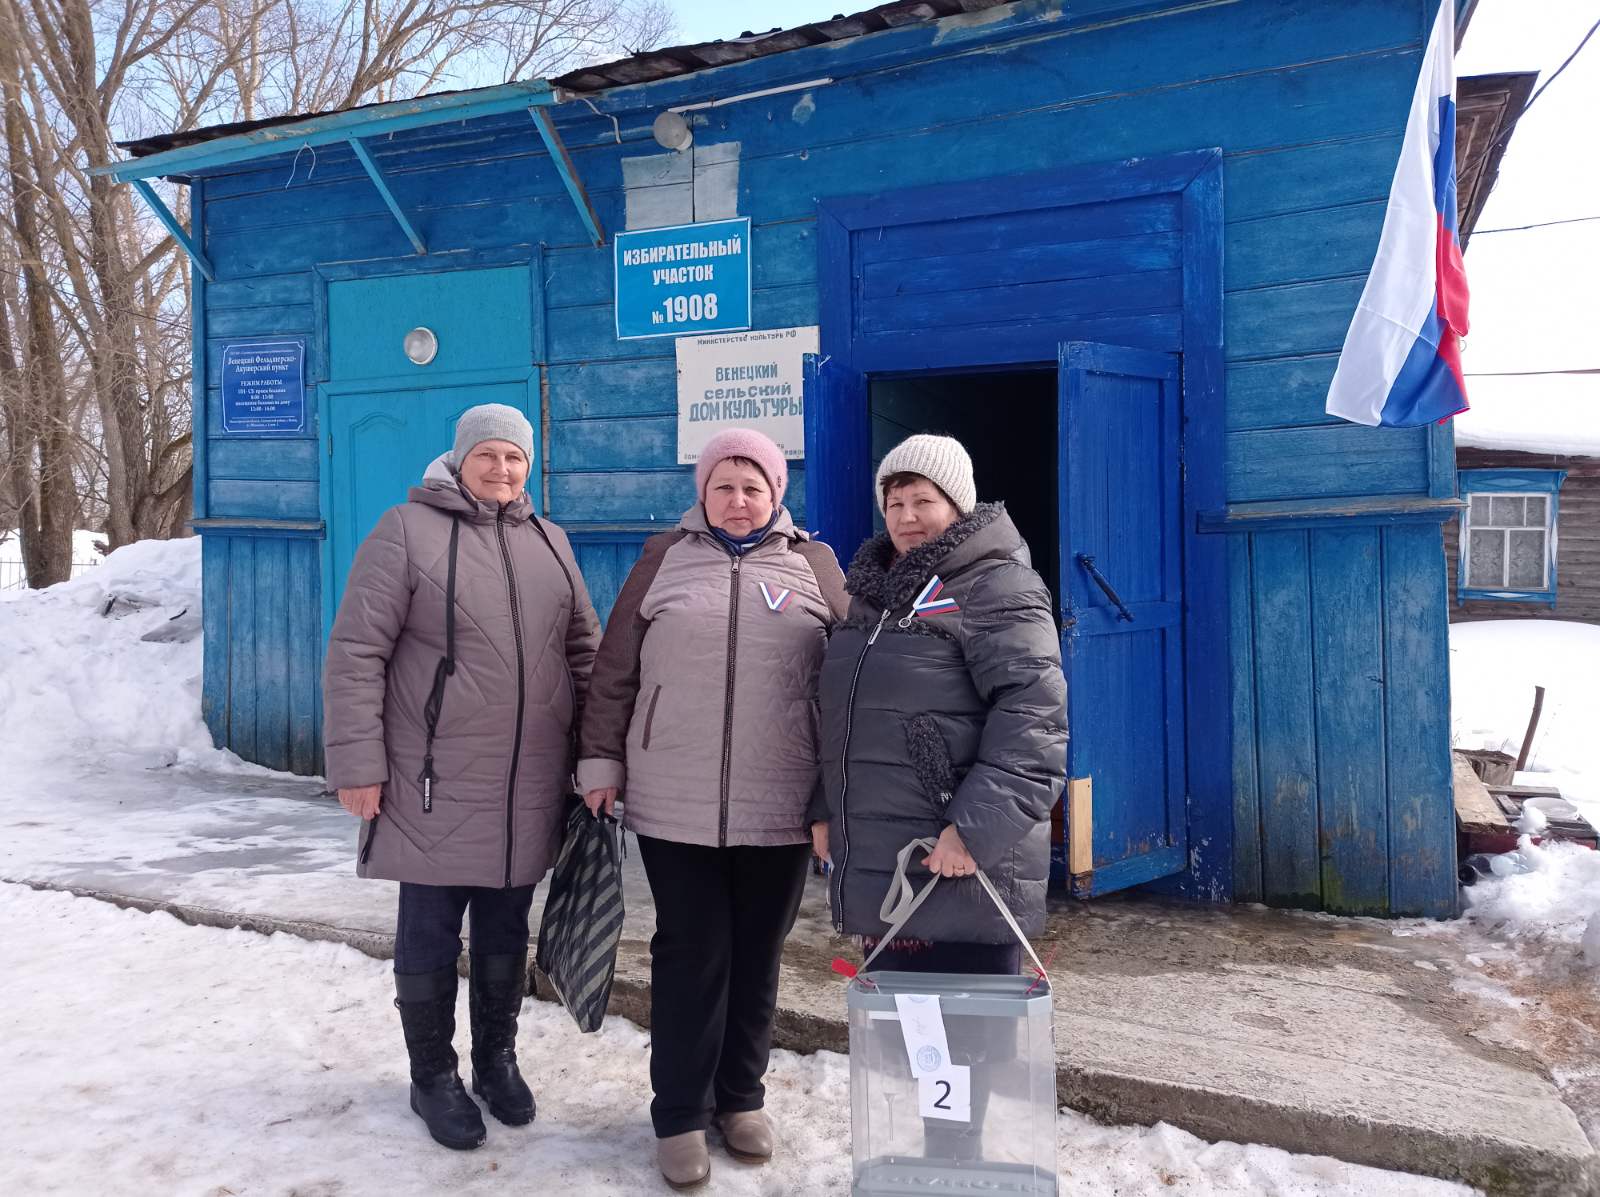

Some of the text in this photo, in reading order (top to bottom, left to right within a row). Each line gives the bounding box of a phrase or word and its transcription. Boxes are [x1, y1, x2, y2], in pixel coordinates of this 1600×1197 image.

[623, 234, 741, 266] ИЗБИРАТЕЛЬНЫЙ
[653, 264, 714, 285] УЧАСТОК
[715, 362, 778, 382] ВЕНЕЦКИЙ
[689, 396, 803, 422] ДОМ КУЛЬТУРЫ
[933, 1080, 952, 1110] 2
